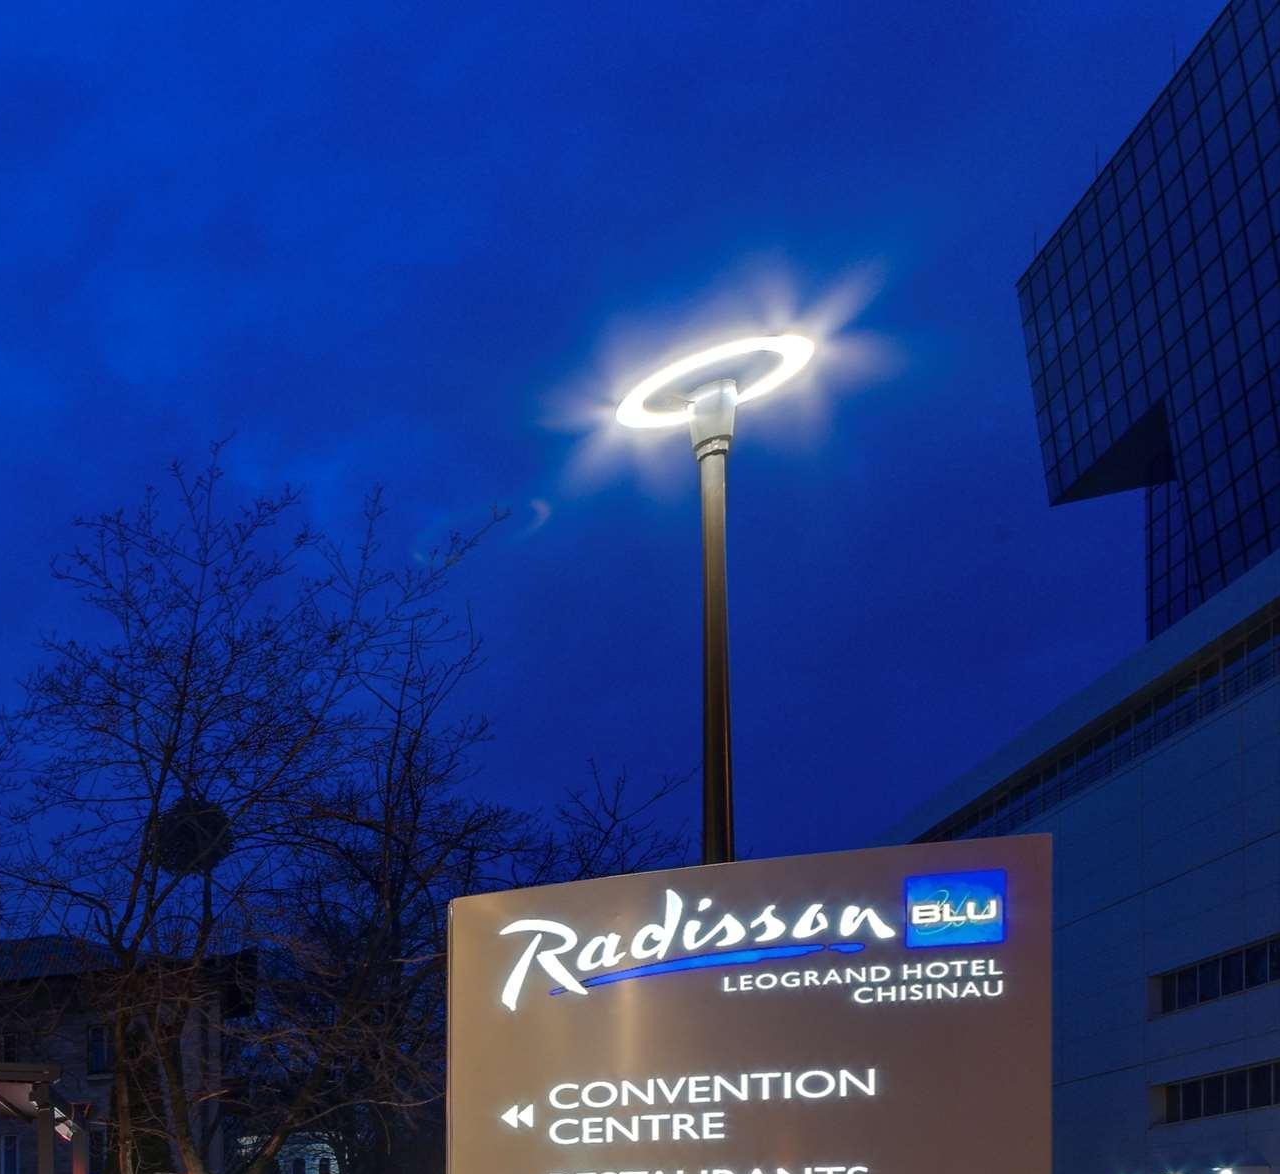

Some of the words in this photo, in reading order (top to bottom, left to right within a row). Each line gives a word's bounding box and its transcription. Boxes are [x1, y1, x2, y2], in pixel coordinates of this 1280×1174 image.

[498, 888, 896, 1011] Radisson
[911, 899, 998, 925] BLU
[722, 965, 891, 993] LEOGRAND
[902, 959, 1004, 980] HOTEL
[853, 979, 1004, 1004] CHISINAU
[548, 1068, 877, 1110] CONVENTION
[548, 1112, 726, 1144] CENTRE
